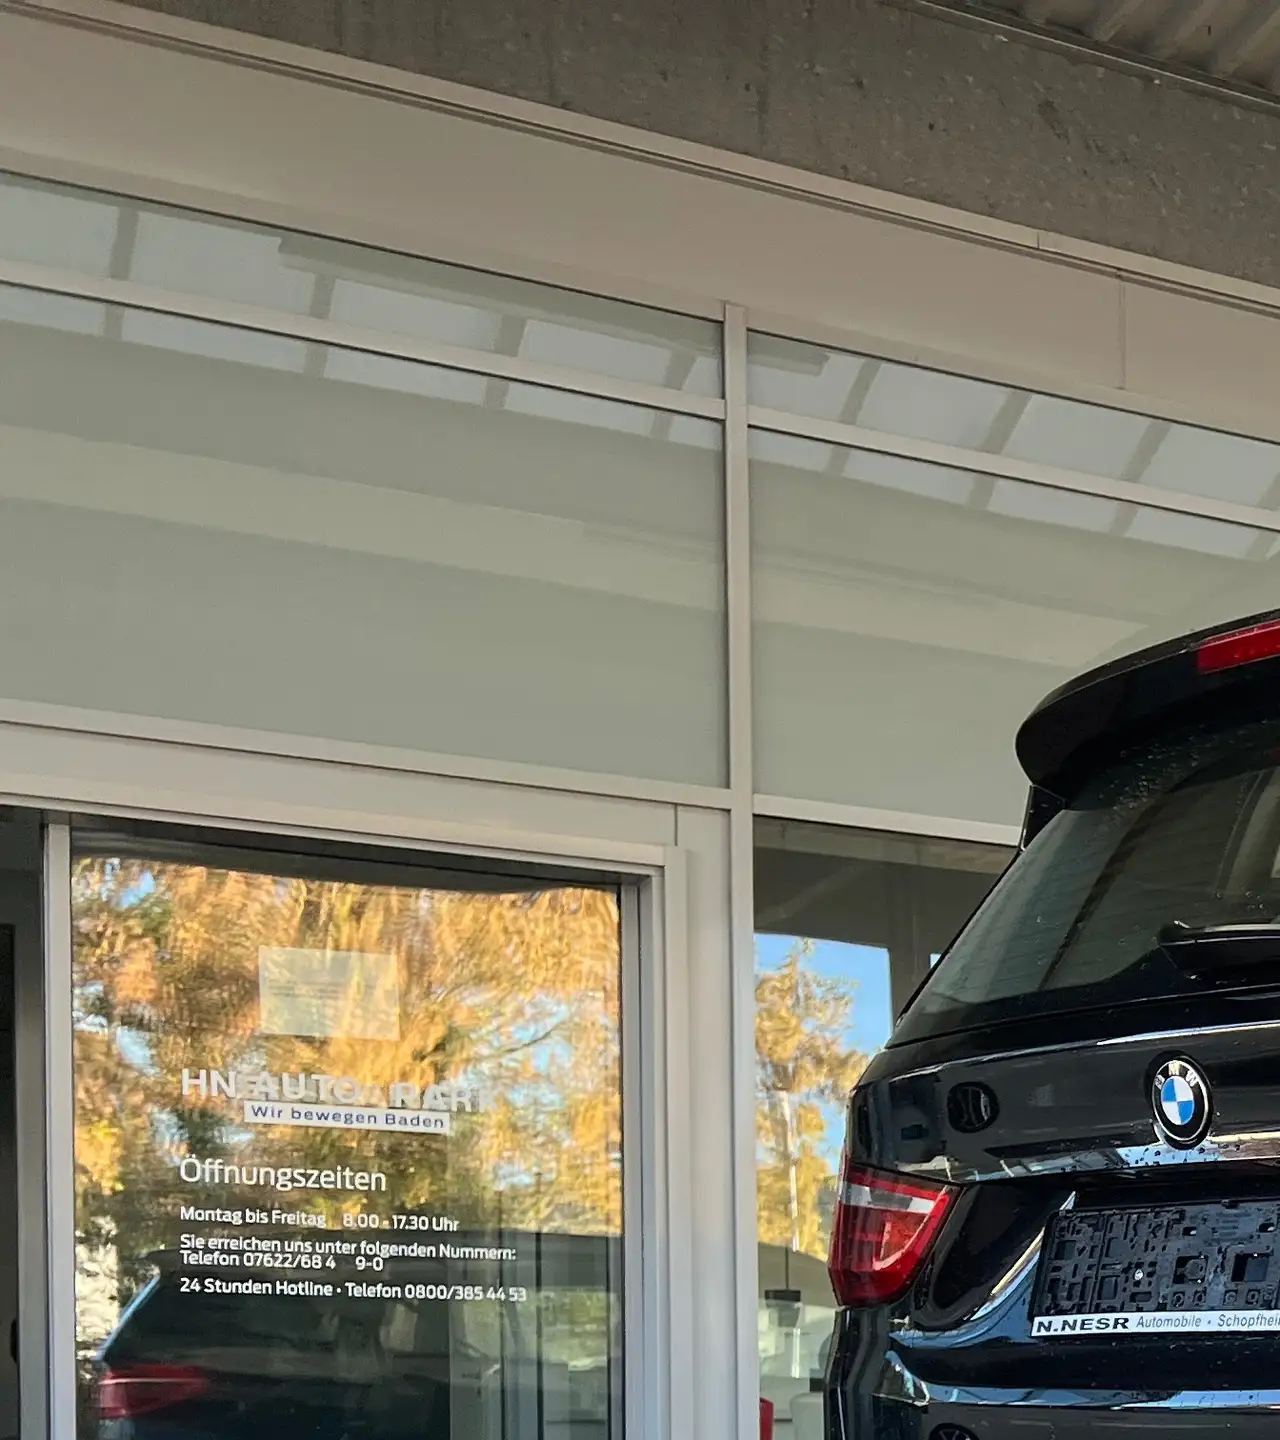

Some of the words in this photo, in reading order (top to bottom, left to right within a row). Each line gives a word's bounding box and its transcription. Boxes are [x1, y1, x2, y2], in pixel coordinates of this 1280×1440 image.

[181, 1068, 237, 1098] HN
[1154, 1061, 1198, 1091] BMW
[251, 1104, 284, 1119] Wir
[290, 1107, 378, 1125] bewegen
[385, 1113, 445, 1129] Baden
[180, 1153, 387, 1192] Öffnungszeiten
[180, 1206, 243, 1225] Montag
[245, 1208, 269, 1224] bis
[271, 1209, 327, 1227] Freitag
[343, 1213, 380, 1228] 8.00
[392, 1215, 429, 1230] 17.30
[432, 1216, 460, 1232] Uhr
[180, 1234, 205, 1249] Sie
[208, 1235, 281, 1251] erreichen
[284, 1241, 313, 1253] uns
[316, 1240, 357, 1255] unter
[360, 1240, 436, 1259] folgenden
[439, 1243, 517, 1261] Nummern:
[180, 1250, 240, 1266] Telefon
[243, 1252, 322, 1269] 07622/68
[355, 1256, 384, 1271] 9-0
[180, 1277, 200, 1293] 24
[203, 1278, 272, 1295] Stunden
[276, 1280, 333, 1296] Hotline
[344, 1282, 401, 1298] Telefon
[404, 1285, 483, 1301] 0800/385
[486, 1286, 505, 1301] 44
[508, 1287, 528, 1302] 53
[1036, 1317, 1130, 1333] N.NESR
[1136, 1314, 1202, 1329] Automobile
